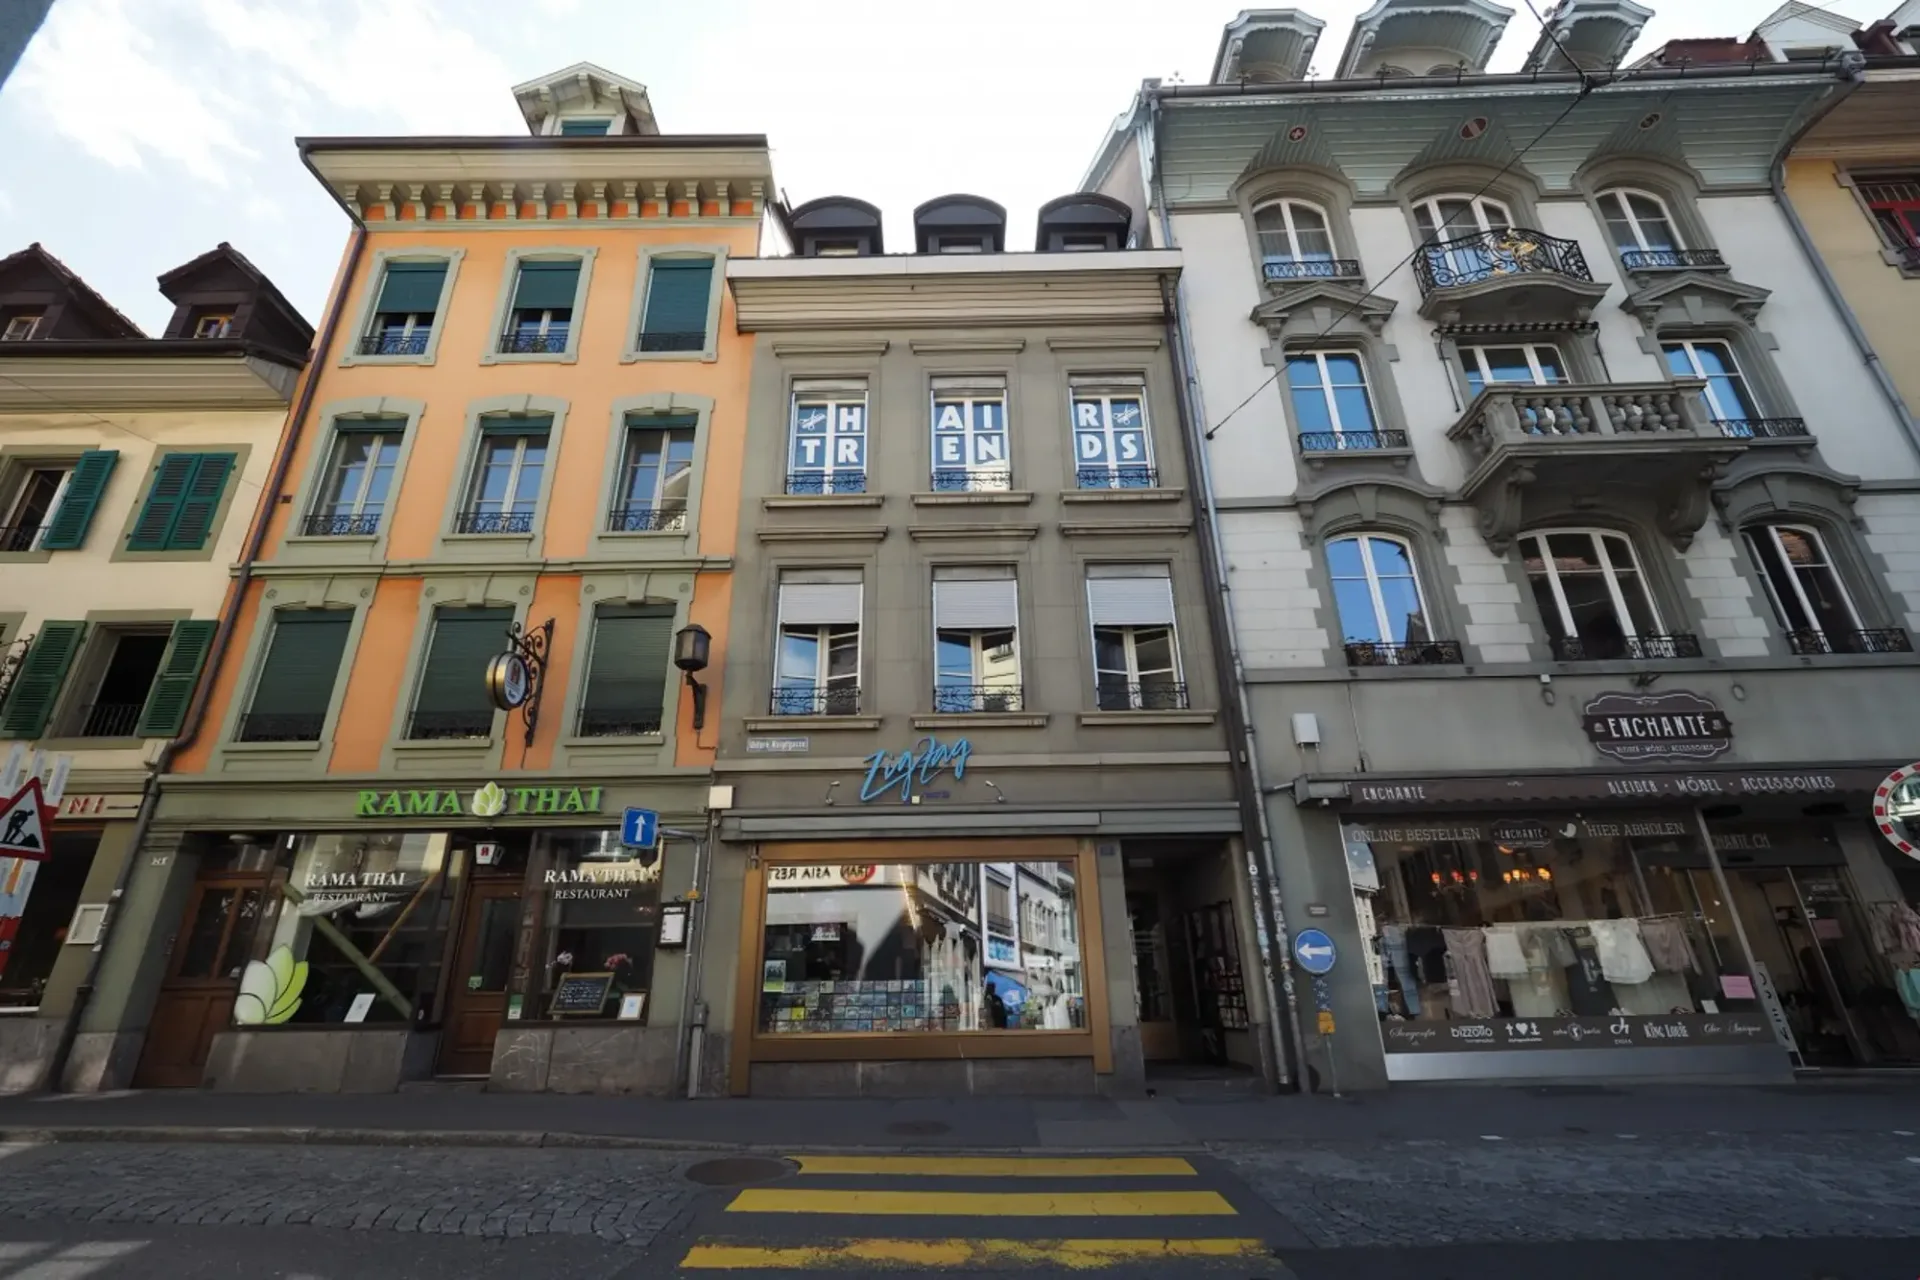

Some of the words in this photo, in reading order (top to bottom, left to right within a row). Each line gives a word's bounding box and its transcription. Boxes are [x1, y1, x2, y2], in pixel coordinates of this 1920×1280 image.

[1741, 776, 1836, 791] ACCESSOIRES
[356, 789, 465, 817] RAMA
[514, 786, 603, 815] THAI
[1352, 829, 1402, 842] ONLINE
[1406, 827, 1481, 842] BESTELLEN
[1587, 822, 1620, 837] HIER
[1623, 822, 1686, 837] ABHOLEN
[304, 872, 357, 886] RAMA
[361, 872, 406, 886] THAI
[544, 869, 597, 883] RAMA
[313, 892, 388, 902] RESTAURANT
[554, 889, 631, 900] RESTAURANT
